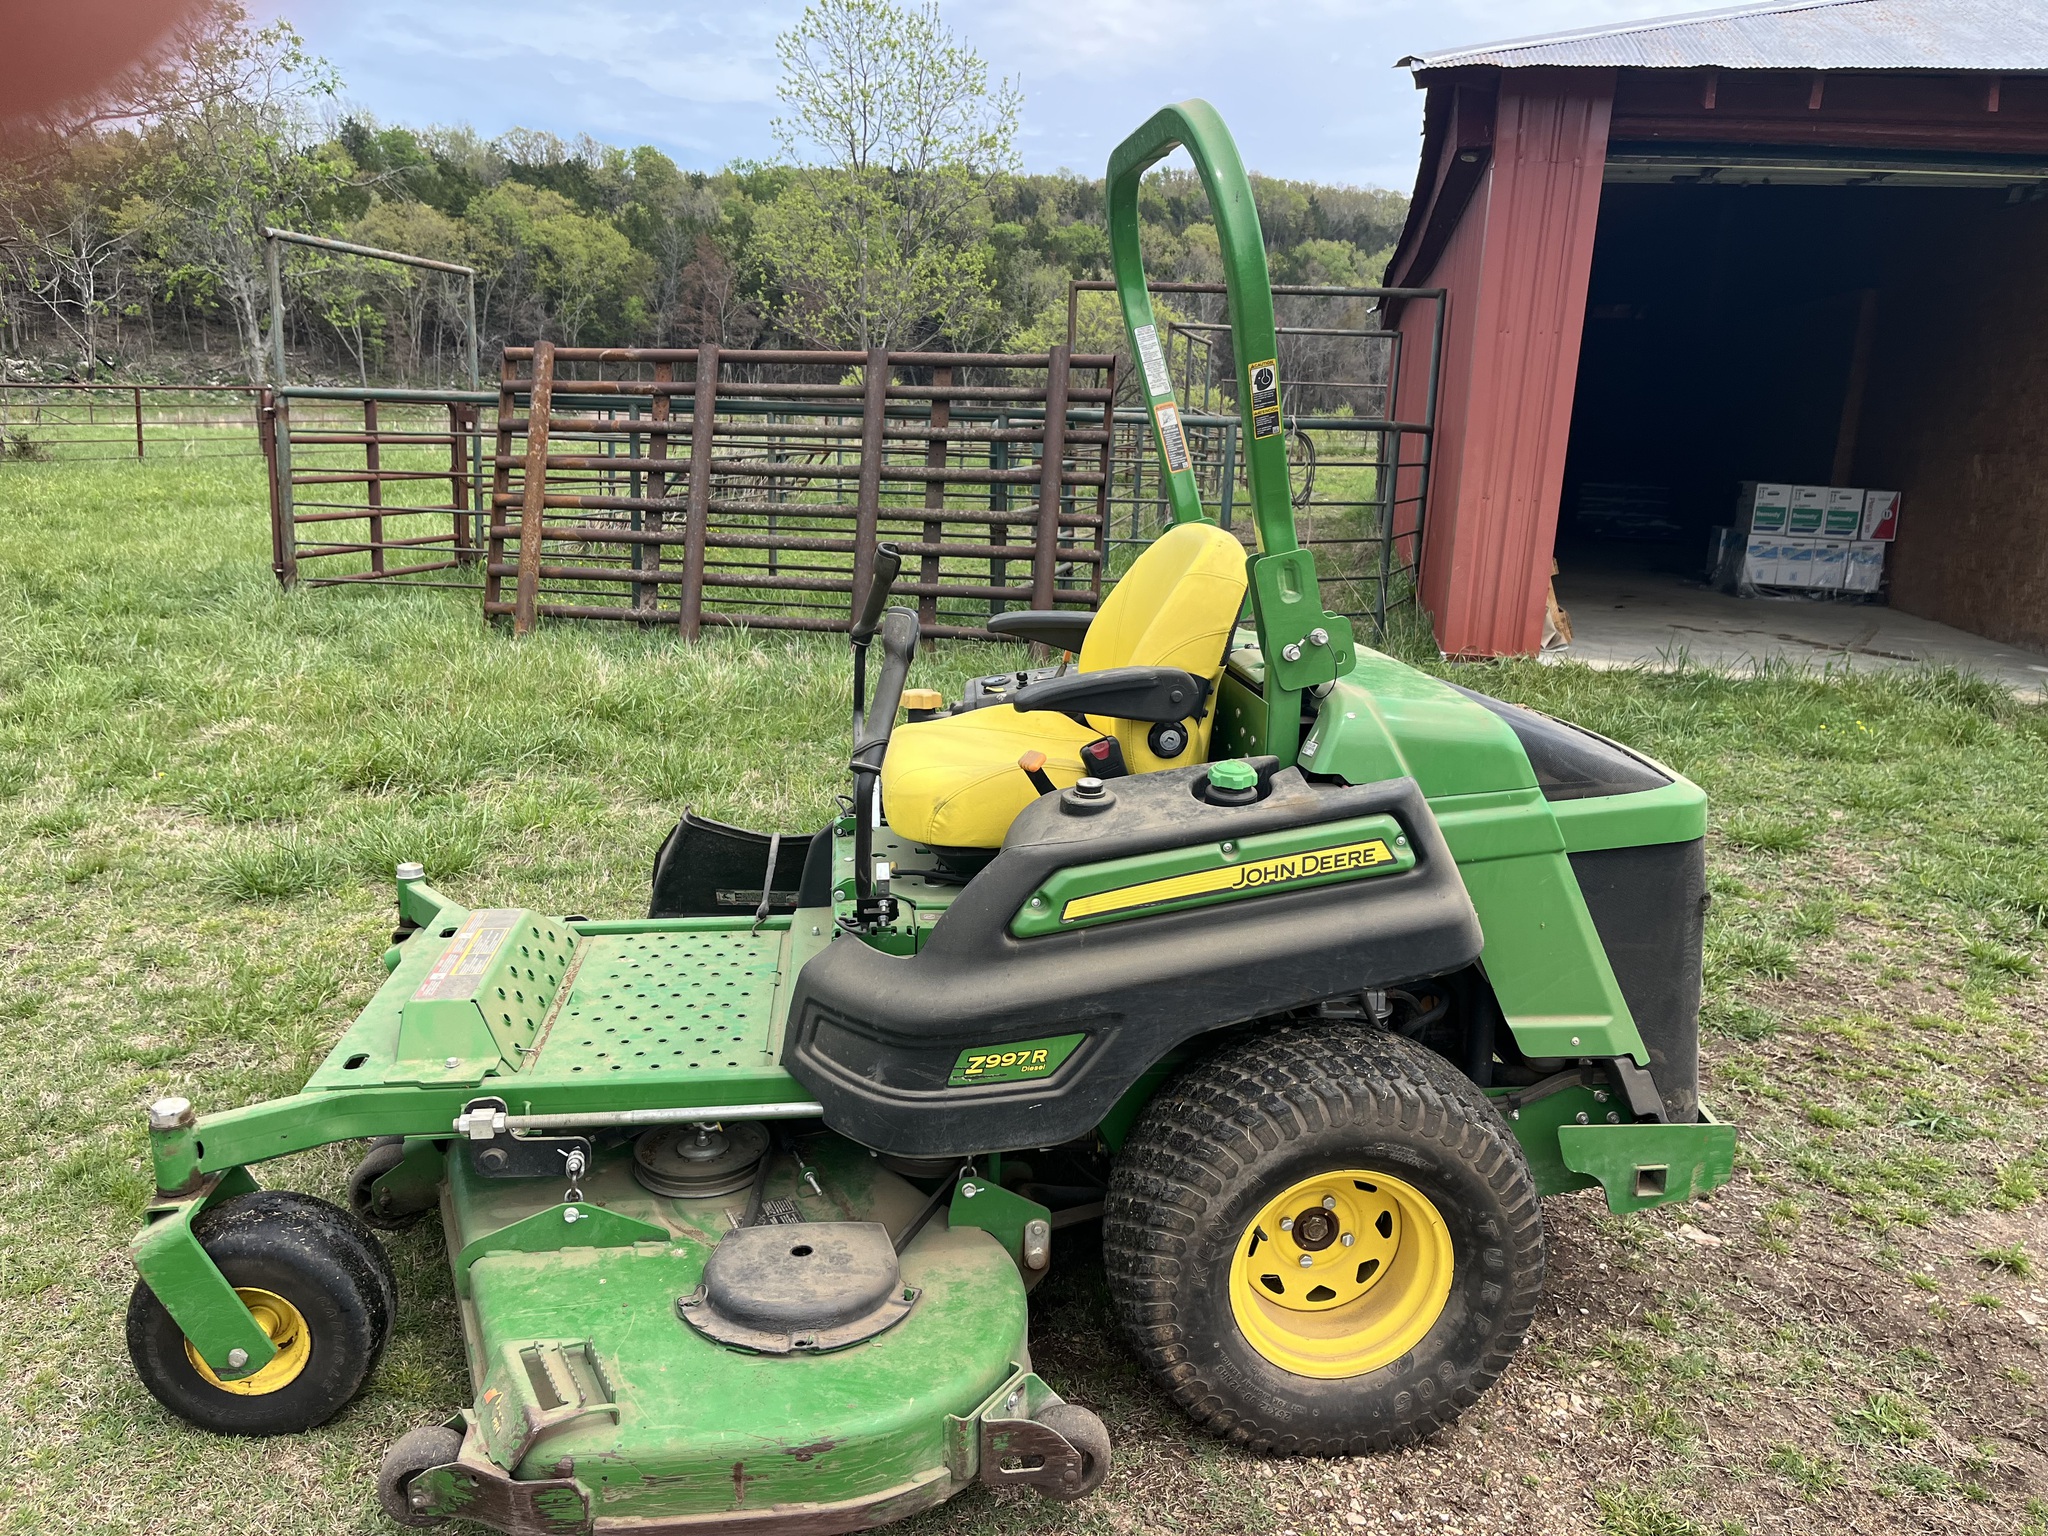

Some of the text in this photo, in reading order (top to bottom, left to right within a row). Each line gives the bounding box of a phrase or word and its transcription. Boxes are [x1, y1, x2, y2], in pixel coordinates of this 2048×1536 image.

[1233, 848, 1376, 887] JOHN DEERE
[964, 1049, 1048, 1075] Z997R
[1020, 1064, 1047, 1073] Diesel
[1190, 1175, 1265, 1288] KENDA
[1394, 1219, 1504, 1414] TURF 505
